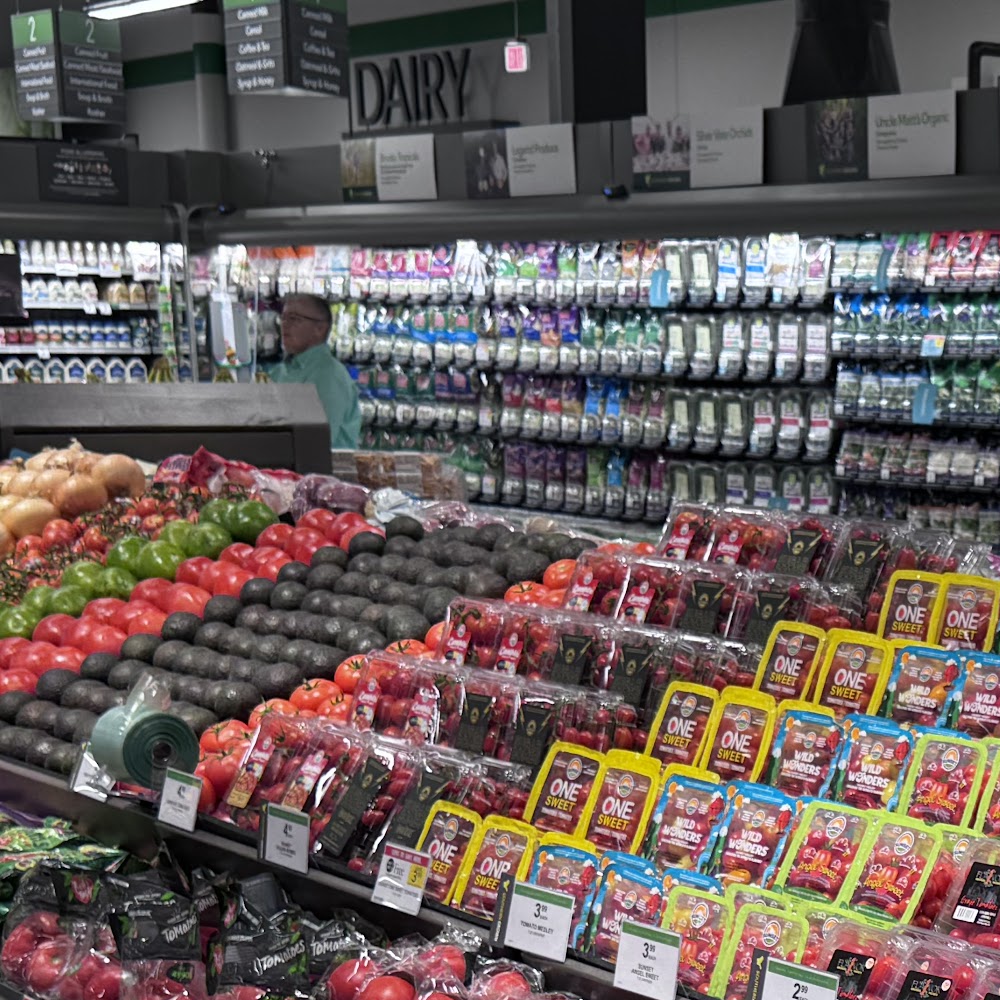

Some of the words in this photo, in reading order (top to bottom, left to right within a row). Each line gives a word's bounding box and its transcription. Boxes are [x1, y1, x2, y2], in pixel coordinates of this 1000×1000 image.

[28, 16, 37, 42] 2
[85, 19, 95, 44] 2
[354, 48, 471, 127] DAIRY
[895, 604, 928, 624] ONE
[947, 609, 980, 631] ONE
[892, 620, 921, 635] SWEET
[944, 626, 978, 641] SWEET
[774, 655, 803, 677] ONE
[769, 672, 798, 687] SWEET
[834, 668, 867, 691] ONE
[830, 685, 862, 701] SWEET
[910, 683, 931, 696] WILD
[898, 692, 938, 709] WONDERS
[667, 717, 698, 739] ONE
[662, 733, 692, 749] SWEET
[721, 731, 753, 754] ONE
[717, 749, 748, 765] SWEET
[794, 750, 815, 762] WILD
[783, 759, 822, 776] WONDERS
[550, 778, 583, 803] ONE
[545, 796, 577, 813] SWEET
[601, 795, 635, 821] ONE
[597, 814, 629, 832] SWEET
[676, 815, 696, 829] WILD
[662, 826, 703, 843] WONDERS
[741, 828, 763, 843] WILD
[728, 838, 769, 857] WONDERS
